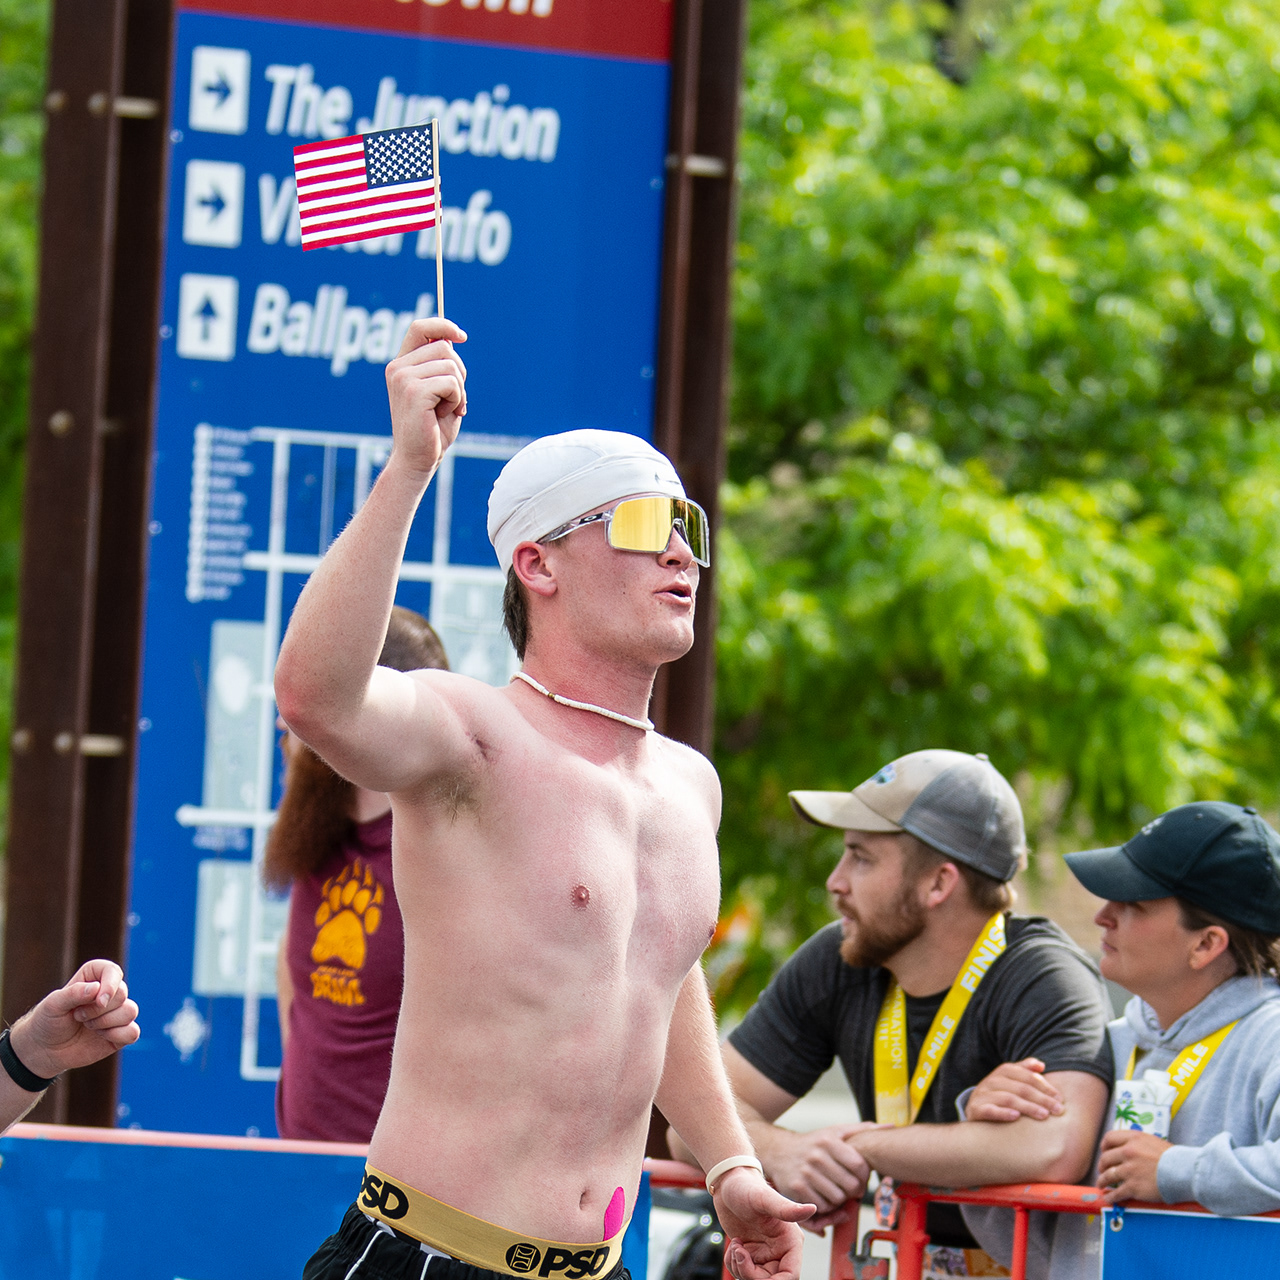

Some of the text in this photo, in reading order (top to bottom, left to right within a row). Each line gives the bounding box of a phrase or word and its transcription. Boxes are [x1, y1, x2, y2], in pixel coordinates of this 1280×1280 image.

[265, 63, 352, 140] The
[927, 1015, 956, 1060] MILE
[1172, 1042, 1209, 1087] MILE
[538, 1246, 610, 1279] PSD
